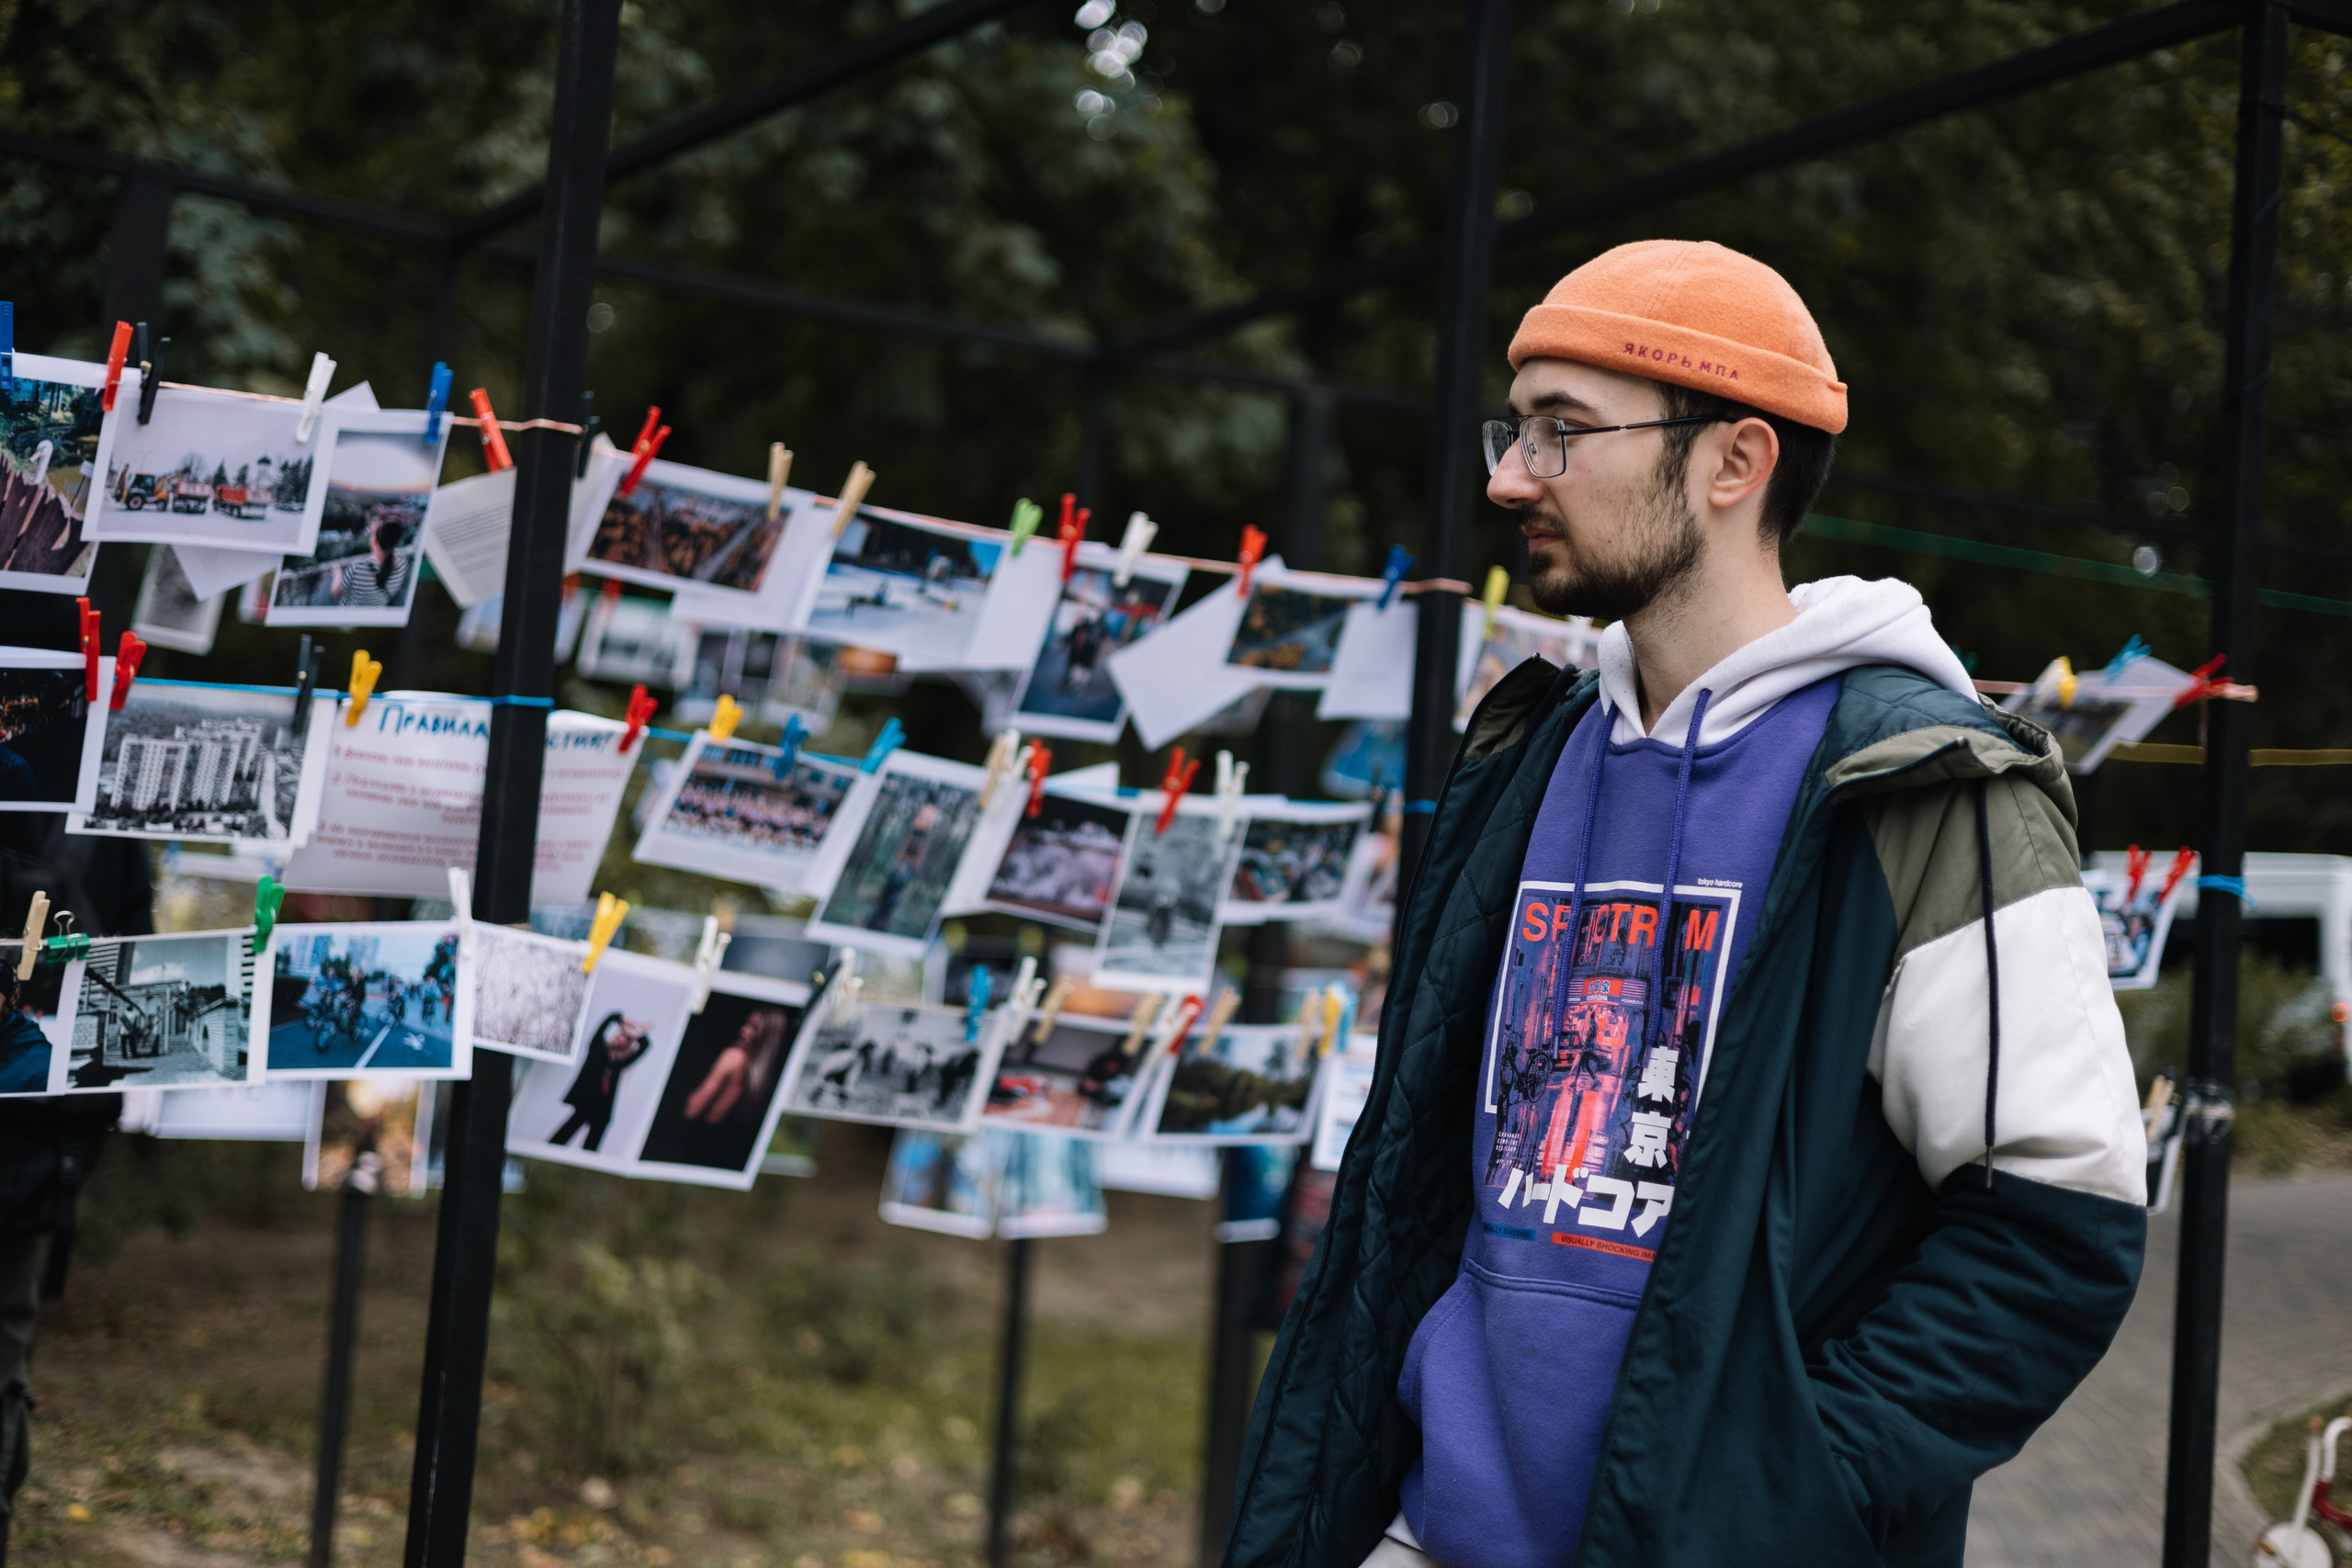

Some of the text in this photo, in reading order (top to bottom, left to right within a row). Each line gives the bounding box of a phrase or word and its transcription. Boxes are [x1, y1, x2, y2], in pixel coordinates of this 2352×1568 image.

[1623, 343, 1691, 368] ЯКОРЬ
[1698, 878, 1743, 888] tokyo hardcore
[1522, 901, 1719, 952] SPCTRM
[1623, 1045, 1679, 1169] 東京
[1498, 1164, 1675, 1238] ハードコア
[1561, 1235, 1595, 1247] VISUALLY
[1597, 1242, 1639, 1257] SHOCKING
